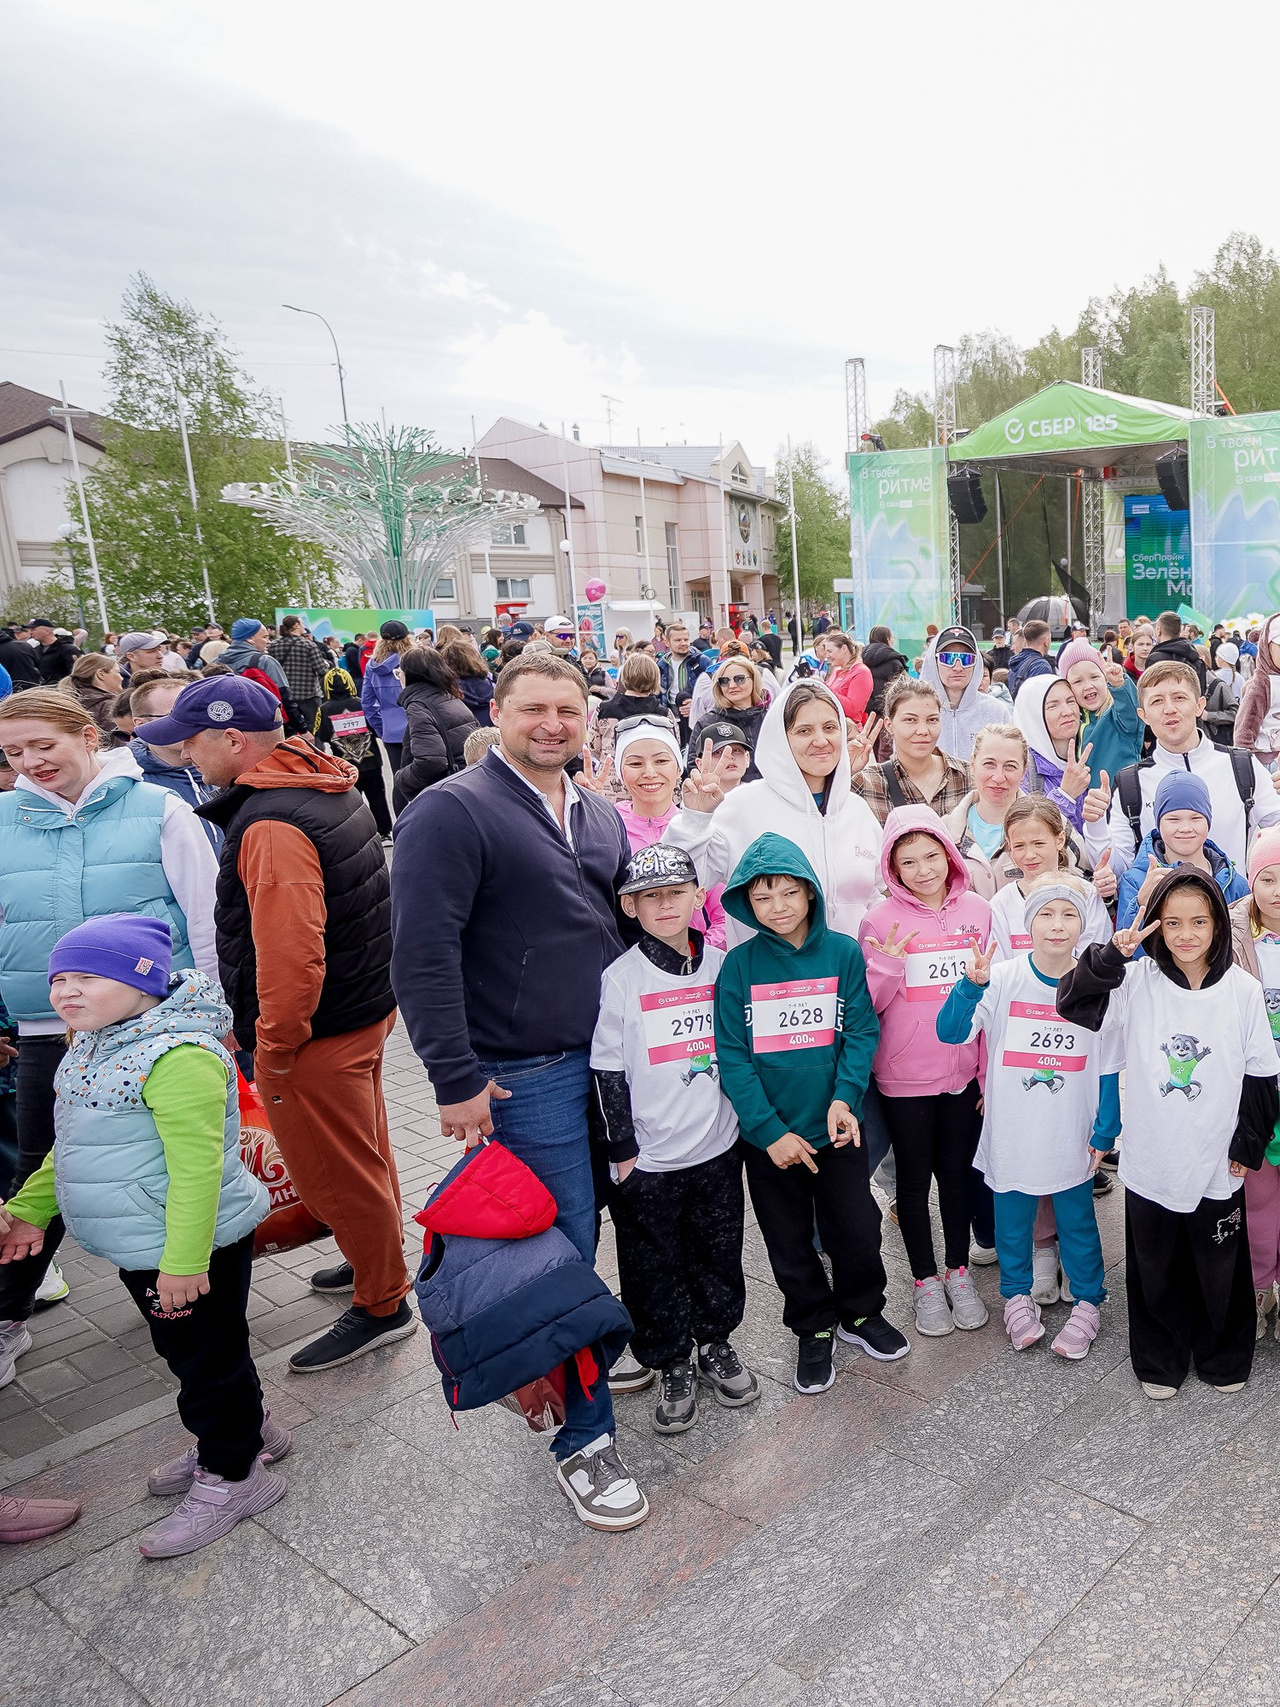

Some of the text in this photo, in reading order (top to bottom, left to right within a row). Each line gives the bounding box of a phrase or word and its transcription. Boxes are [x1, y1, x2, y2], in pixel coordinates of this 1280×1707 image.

[1028, 414, 1119, 438] СБЕР 185
[1205, 433, 1263, 450] В твоём
[878, 475, 932, 500] ритме
[1132, 553, 1185, 562] СберПрайм
[342, 721, 359, 729] 2797
[671, 1013, 713, 1037] 2979
[778, 1007, 824, 1028] 2628
[686, 1040, 711, 1053] 400м
[789, 1034, 815, 1045] 400м
[1030, 1031, 1075, 1050] 2693
[1037, 1056, 1062, 1067] 400м
